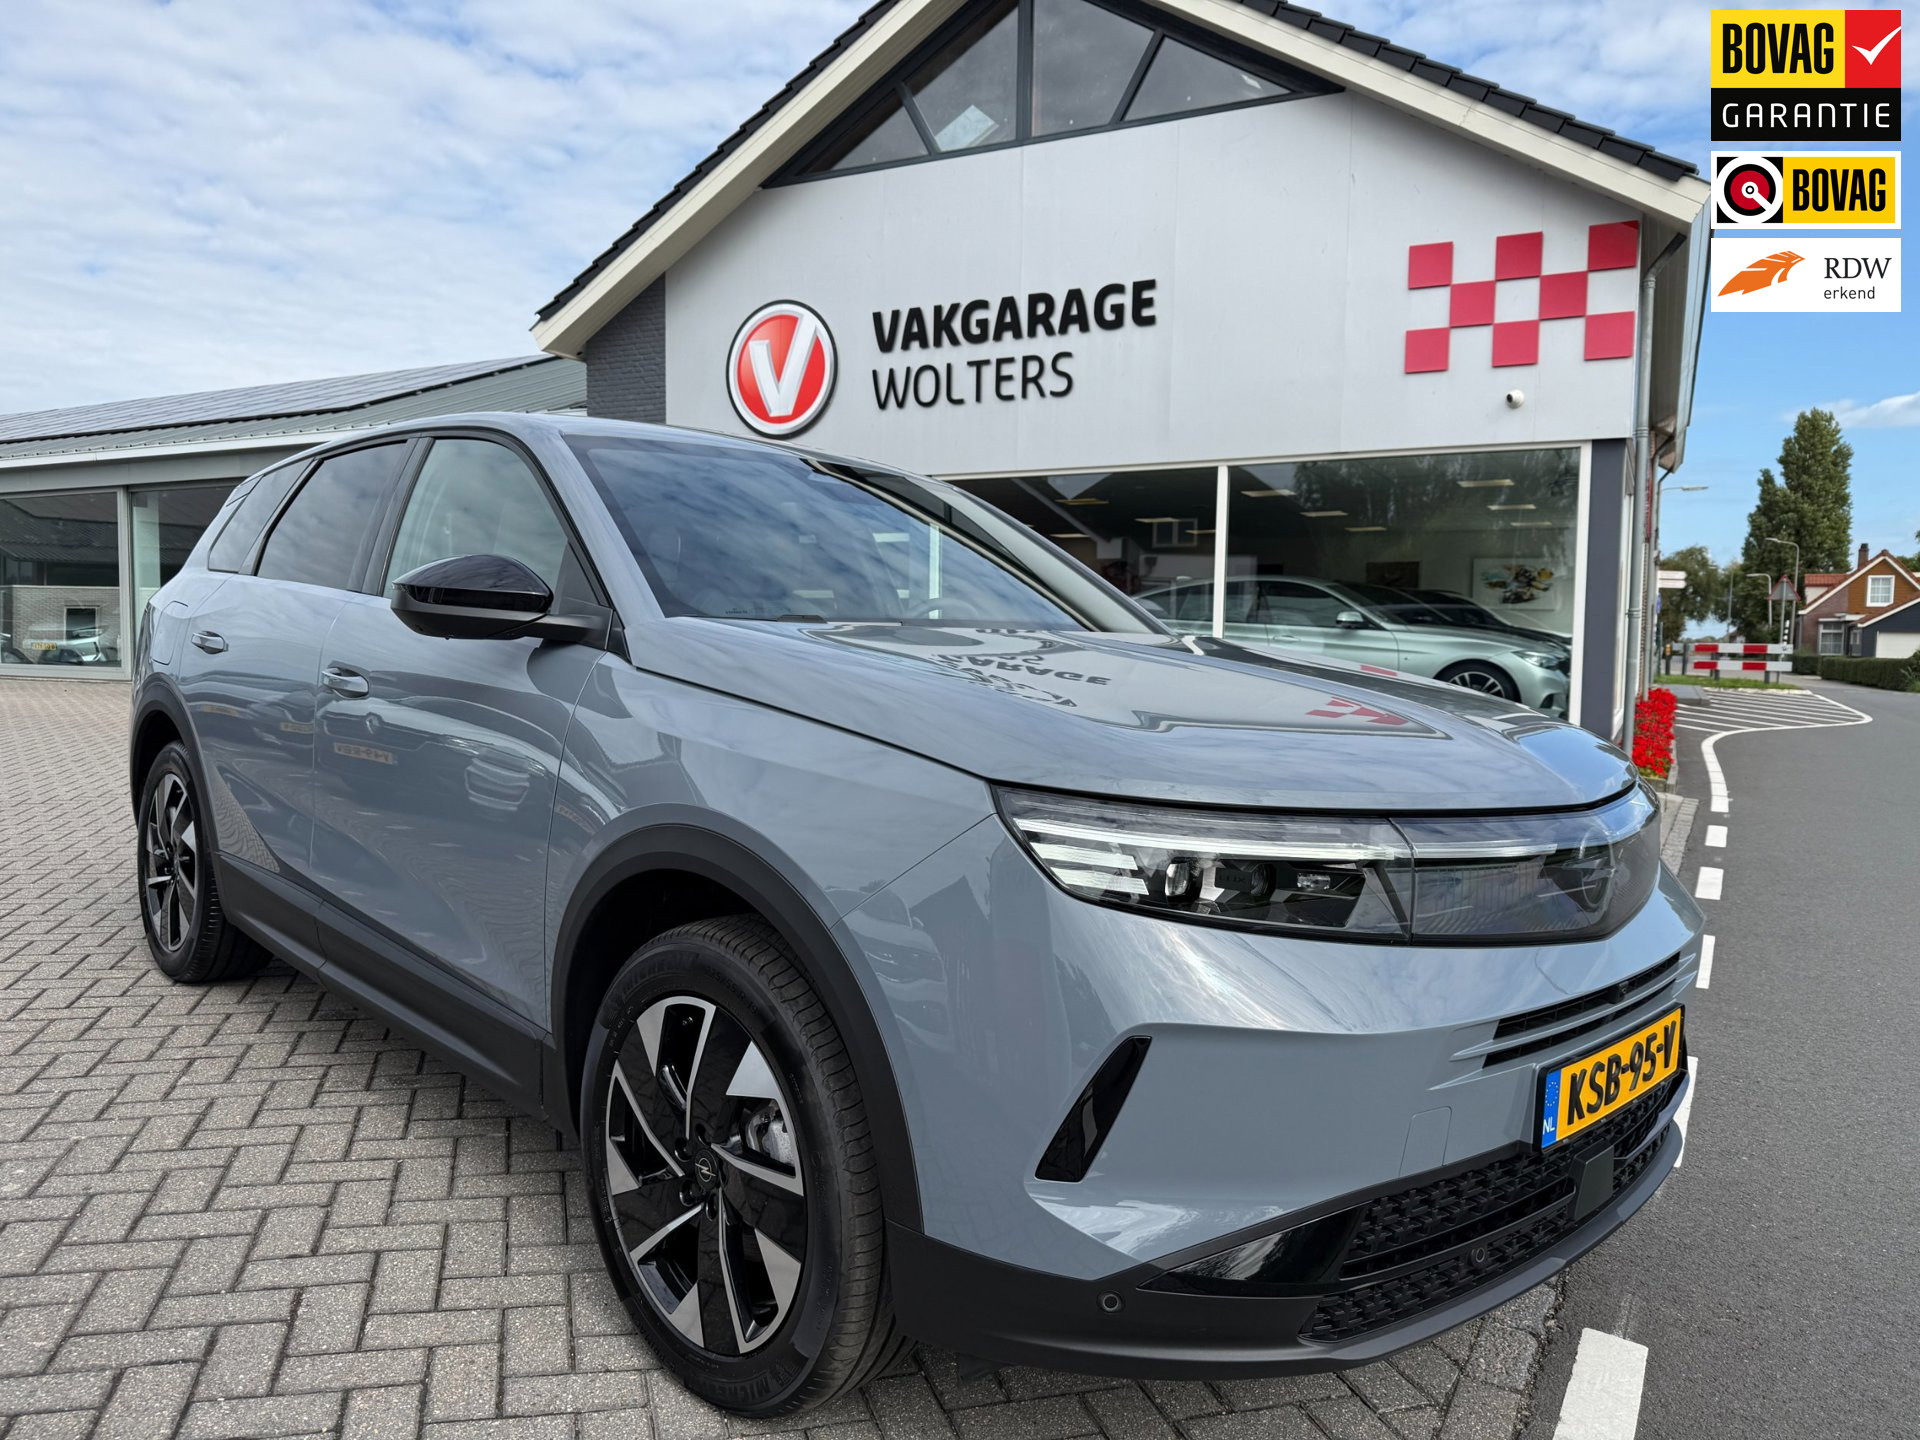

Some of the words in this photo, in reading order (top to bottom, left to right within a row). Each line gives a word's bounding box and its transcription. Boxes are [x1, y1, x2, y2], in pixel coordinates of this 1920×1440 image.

[872, 279, 1157, 353] VAKGARAGE
[872, 351, 1074, 411] WOLTERS
[1568, 1020, 1676, 1126] KSB-95-V
[1542, 1117, 1555, 1134] NL
